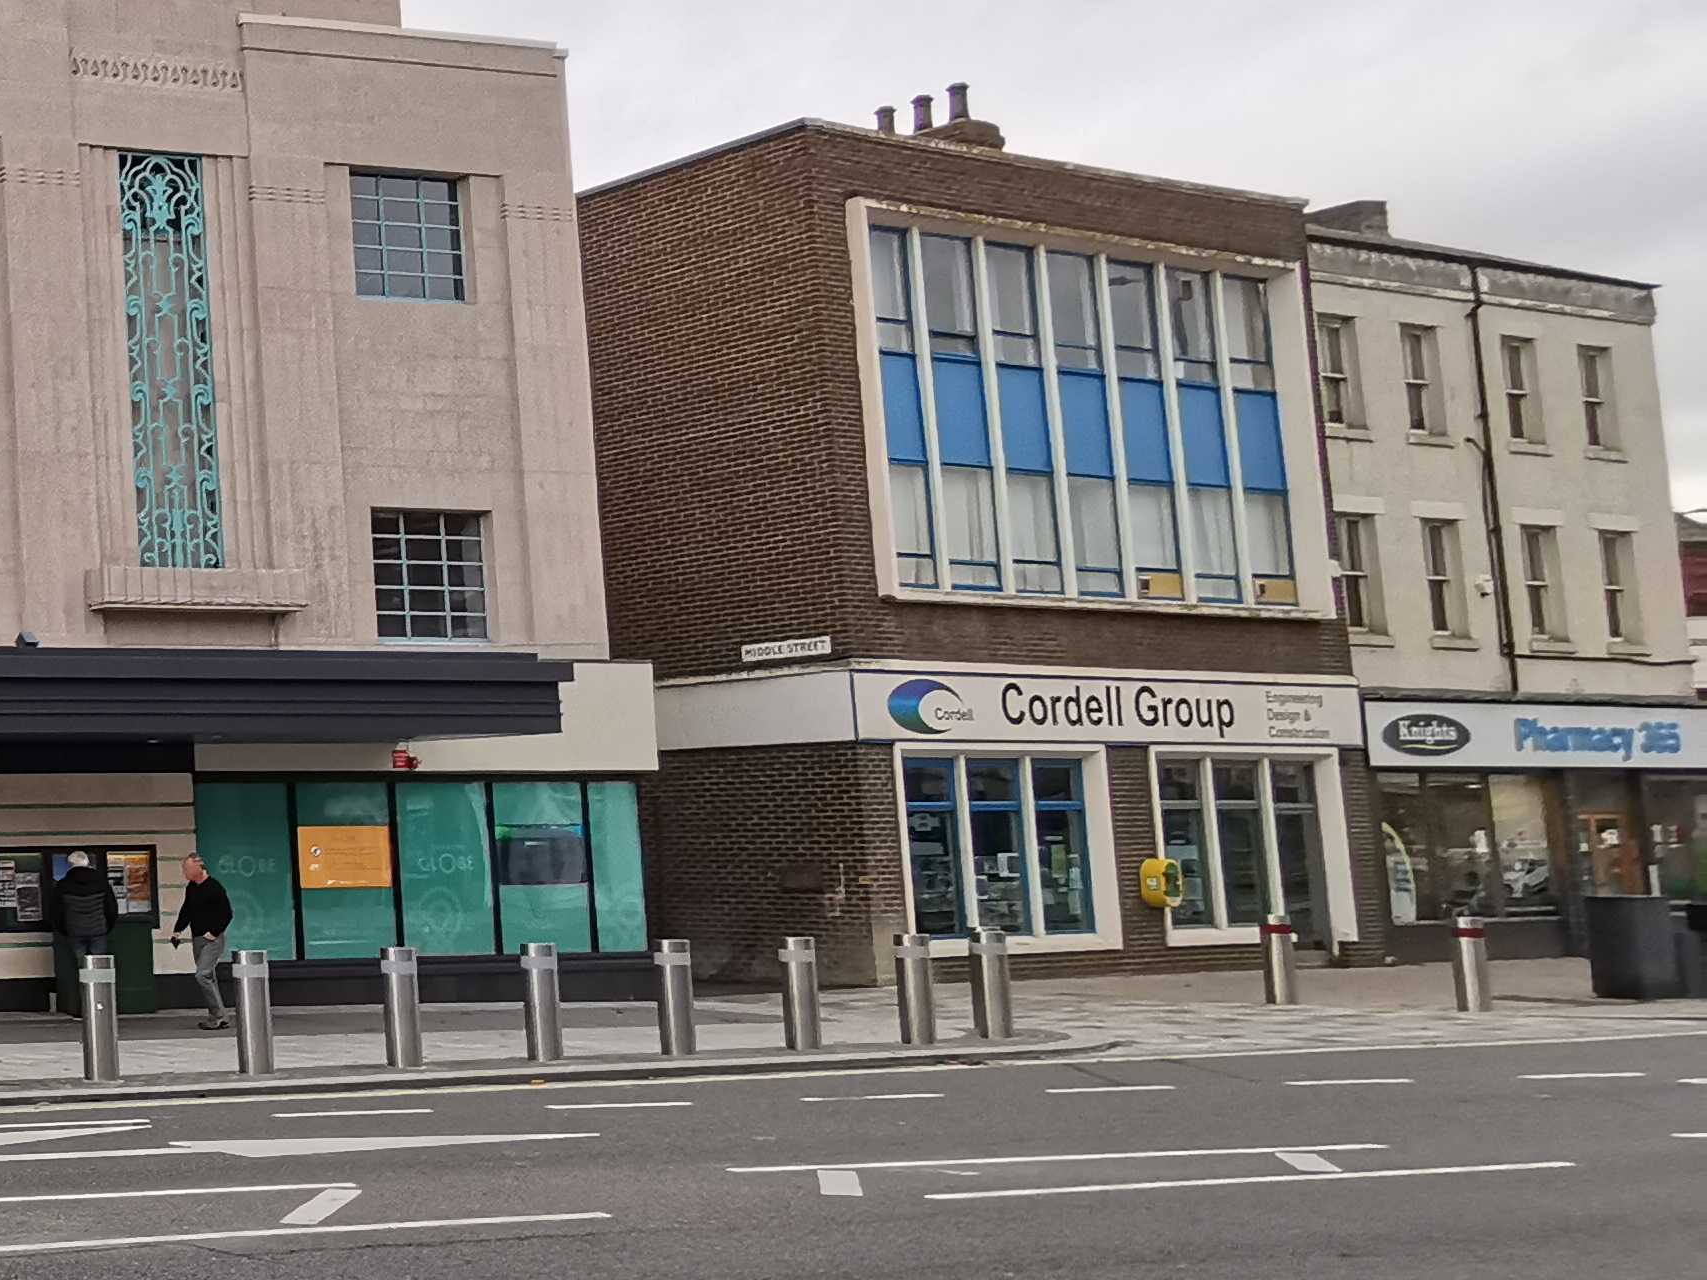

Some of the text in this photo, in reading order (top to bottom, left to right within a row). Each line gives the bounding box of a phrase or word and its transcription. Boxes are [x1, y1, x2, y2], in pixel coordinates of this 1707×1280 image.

[745, 640, 826, 657] MIDDLE STREET
[934, 706, 974, 722] Cordell
[1000, 682, 1235, 738] Cordell Group
[1266, 708, 1301, 724] Design
[1267, 725, 1331, 739] Construction
[1397, 719, 1458, 744] Knights
[1513, 717, 1635, 763] Pharmacy
[217, 854, 277, 877] GLOBE
[416, 852, 476, 875] GLOBE
